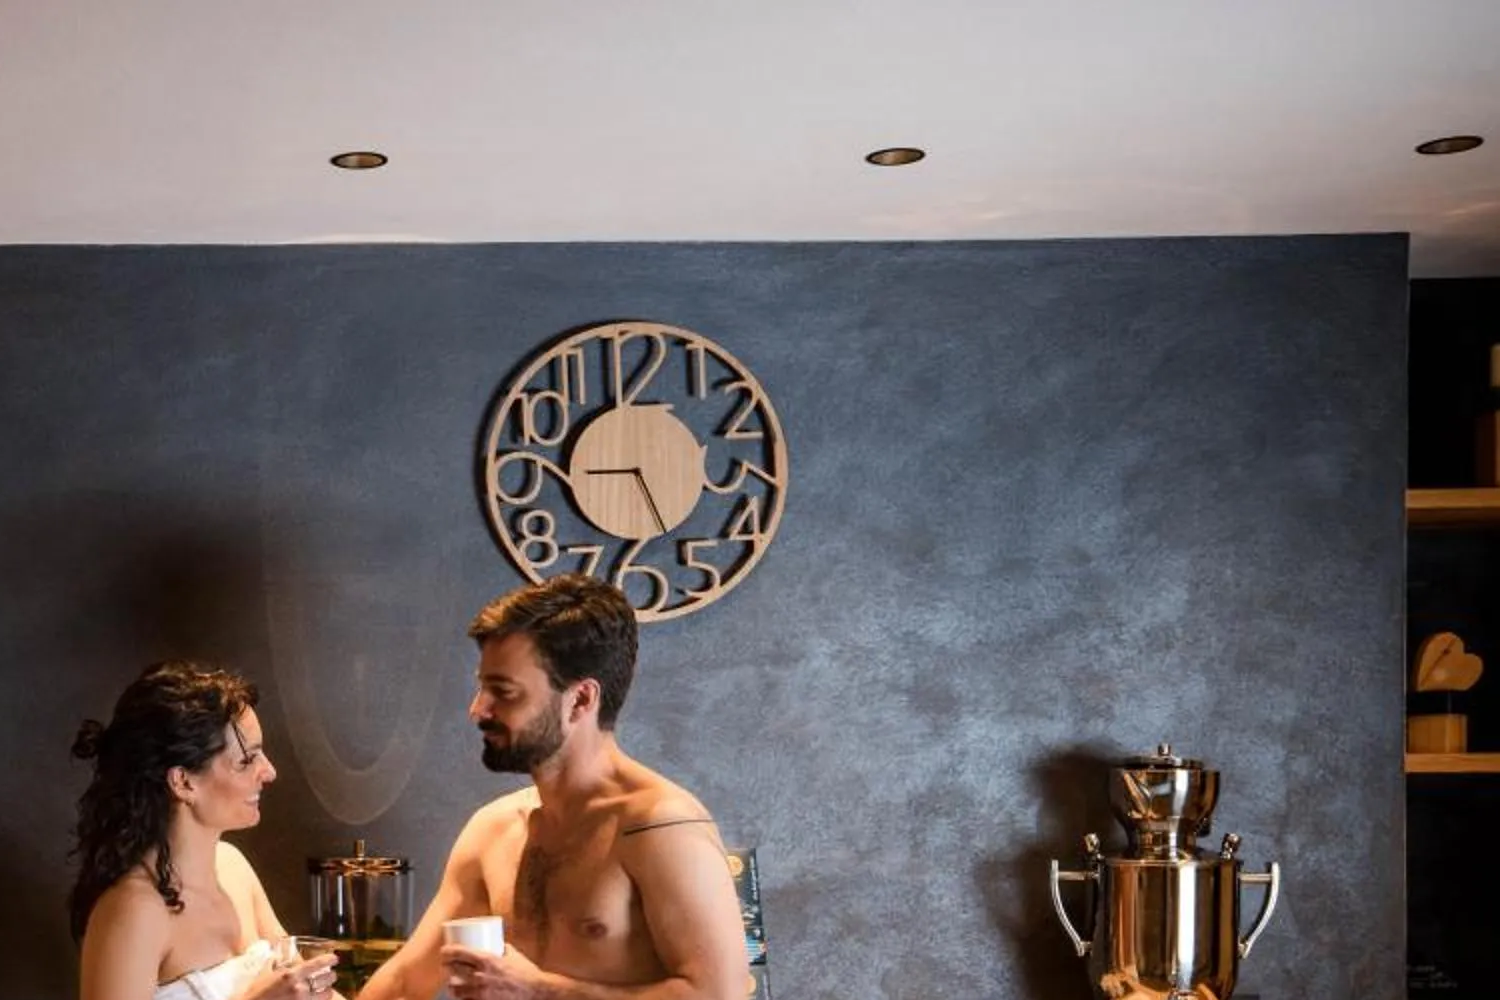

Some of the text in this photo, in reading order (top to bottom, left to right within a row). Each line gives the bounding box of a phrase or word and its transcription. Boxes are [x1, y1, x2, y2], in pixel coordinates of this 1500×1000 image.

[599, 329, 674, 410] 12
[685, 343, 707, 399] 1
[515, 391, 569, 446] 10
[723, 380, 763, 440] 2
[494, 451, 573, 505] 9
[520, 510, 559, 569] 8
[728, 496, 766, 541] 4
[615, 537, 670, 612] 6
[685, 539, 721, 597] 5
